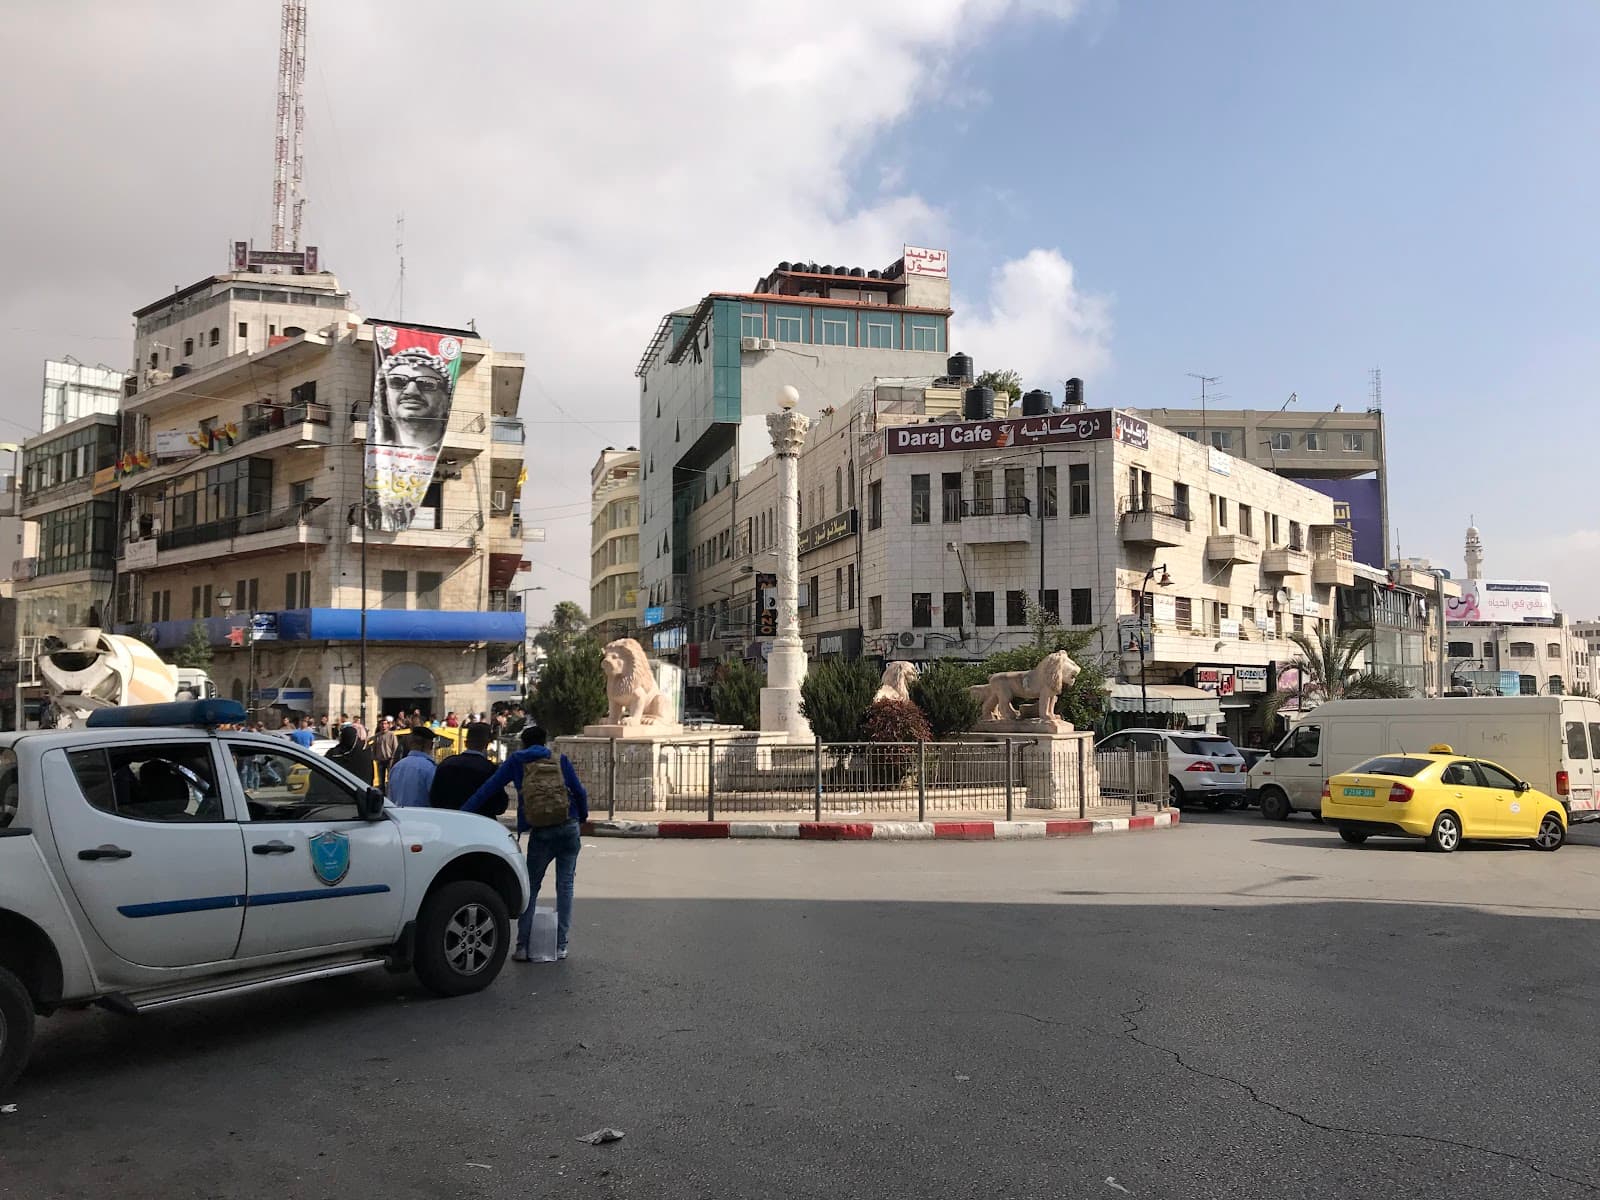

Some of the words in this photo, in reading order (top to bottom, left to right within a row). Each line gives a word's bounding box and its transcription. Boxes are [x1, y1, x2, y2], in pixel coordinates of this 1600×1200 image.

[906, 249, 946, 263] الوليد
[907, 260, 946, 273] مول
[898, 428, 945, 449] Daraj
[950, 425, 993, 443] Cafe
[1020, 417, 1077, 442] كافيه
[1078, 418, 1101, 439] درج
